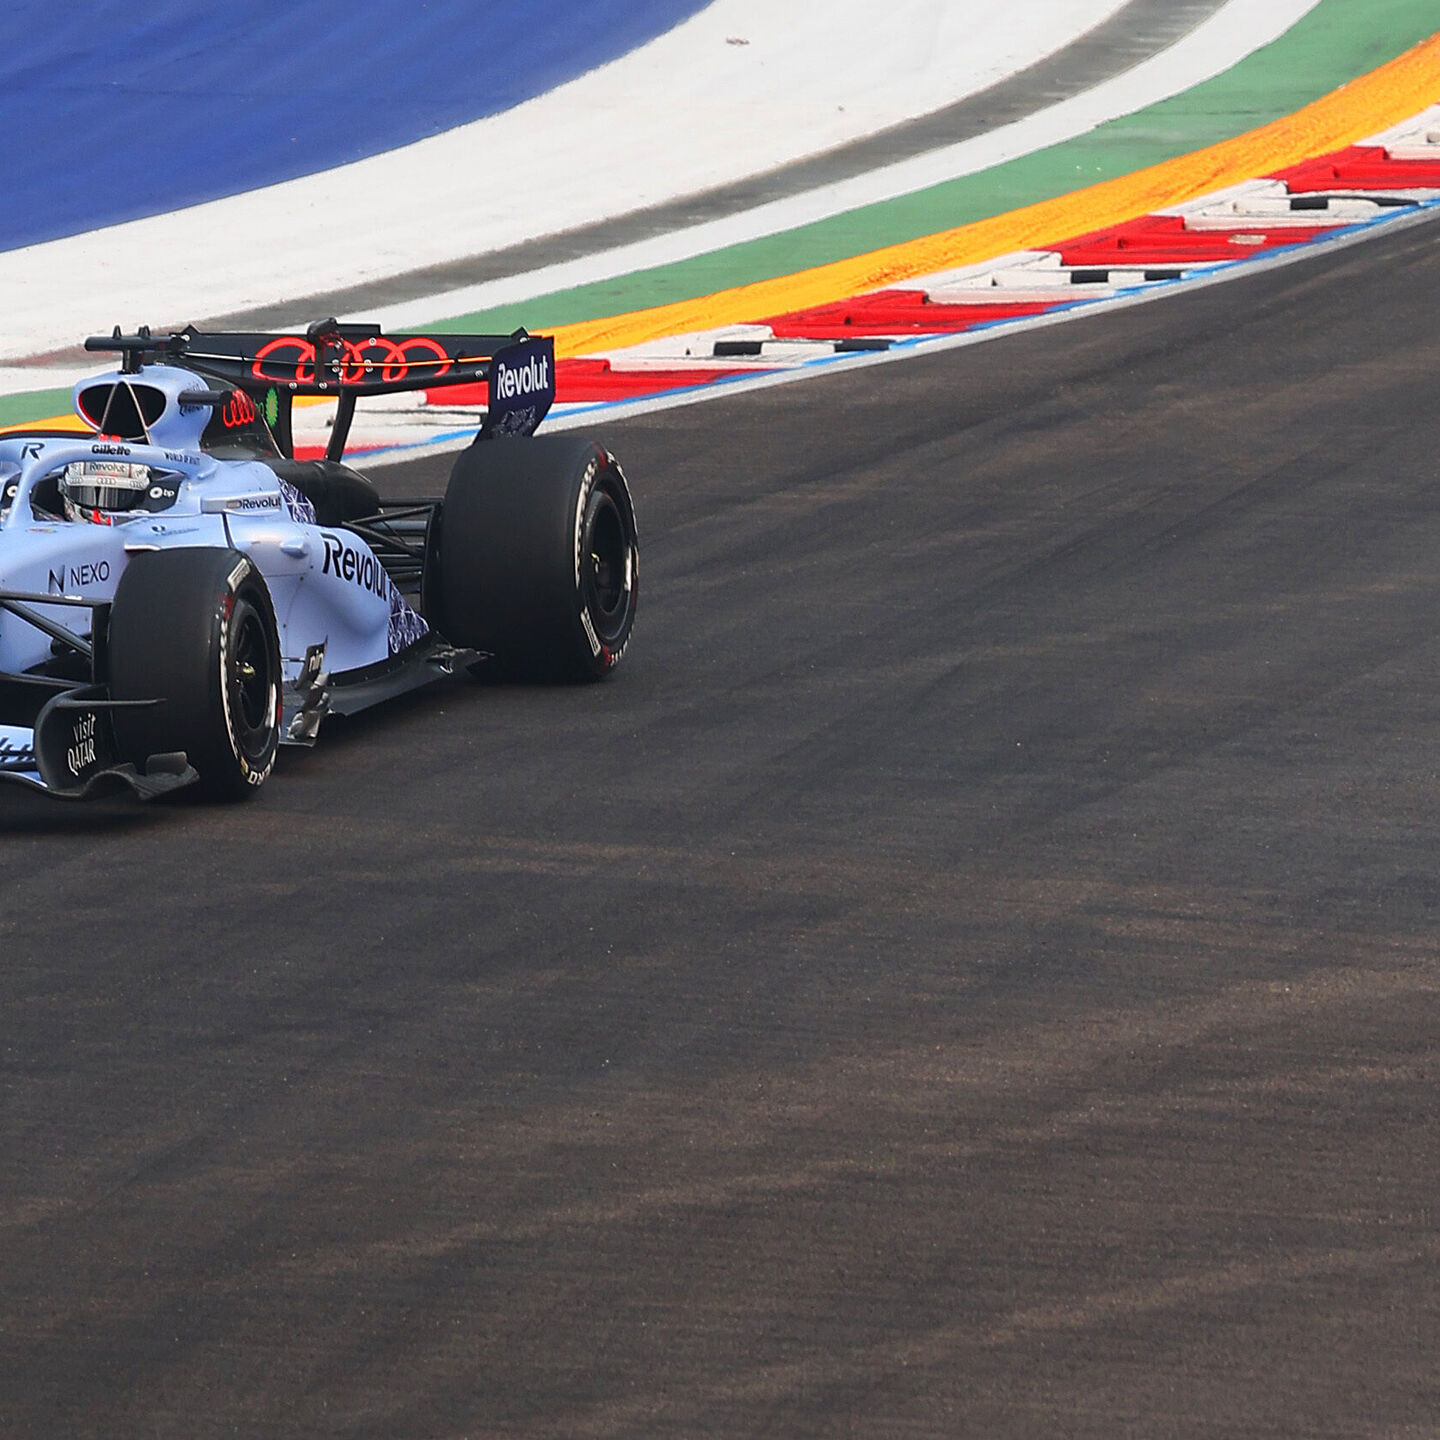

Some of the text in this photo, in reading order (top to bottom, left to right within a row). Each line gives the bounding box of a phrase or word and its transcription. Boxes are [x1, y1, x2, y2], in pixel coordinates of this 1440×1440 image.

[497, 355, 549, 401] Revolut
[91, 444, 132, 456] Gillette
[70, 560, 110, 588] NEXO
[320, 533, 388, 601] Revolut
[72, 713, 97, 743] visit
[67, 738, 96, 777] QATAR
